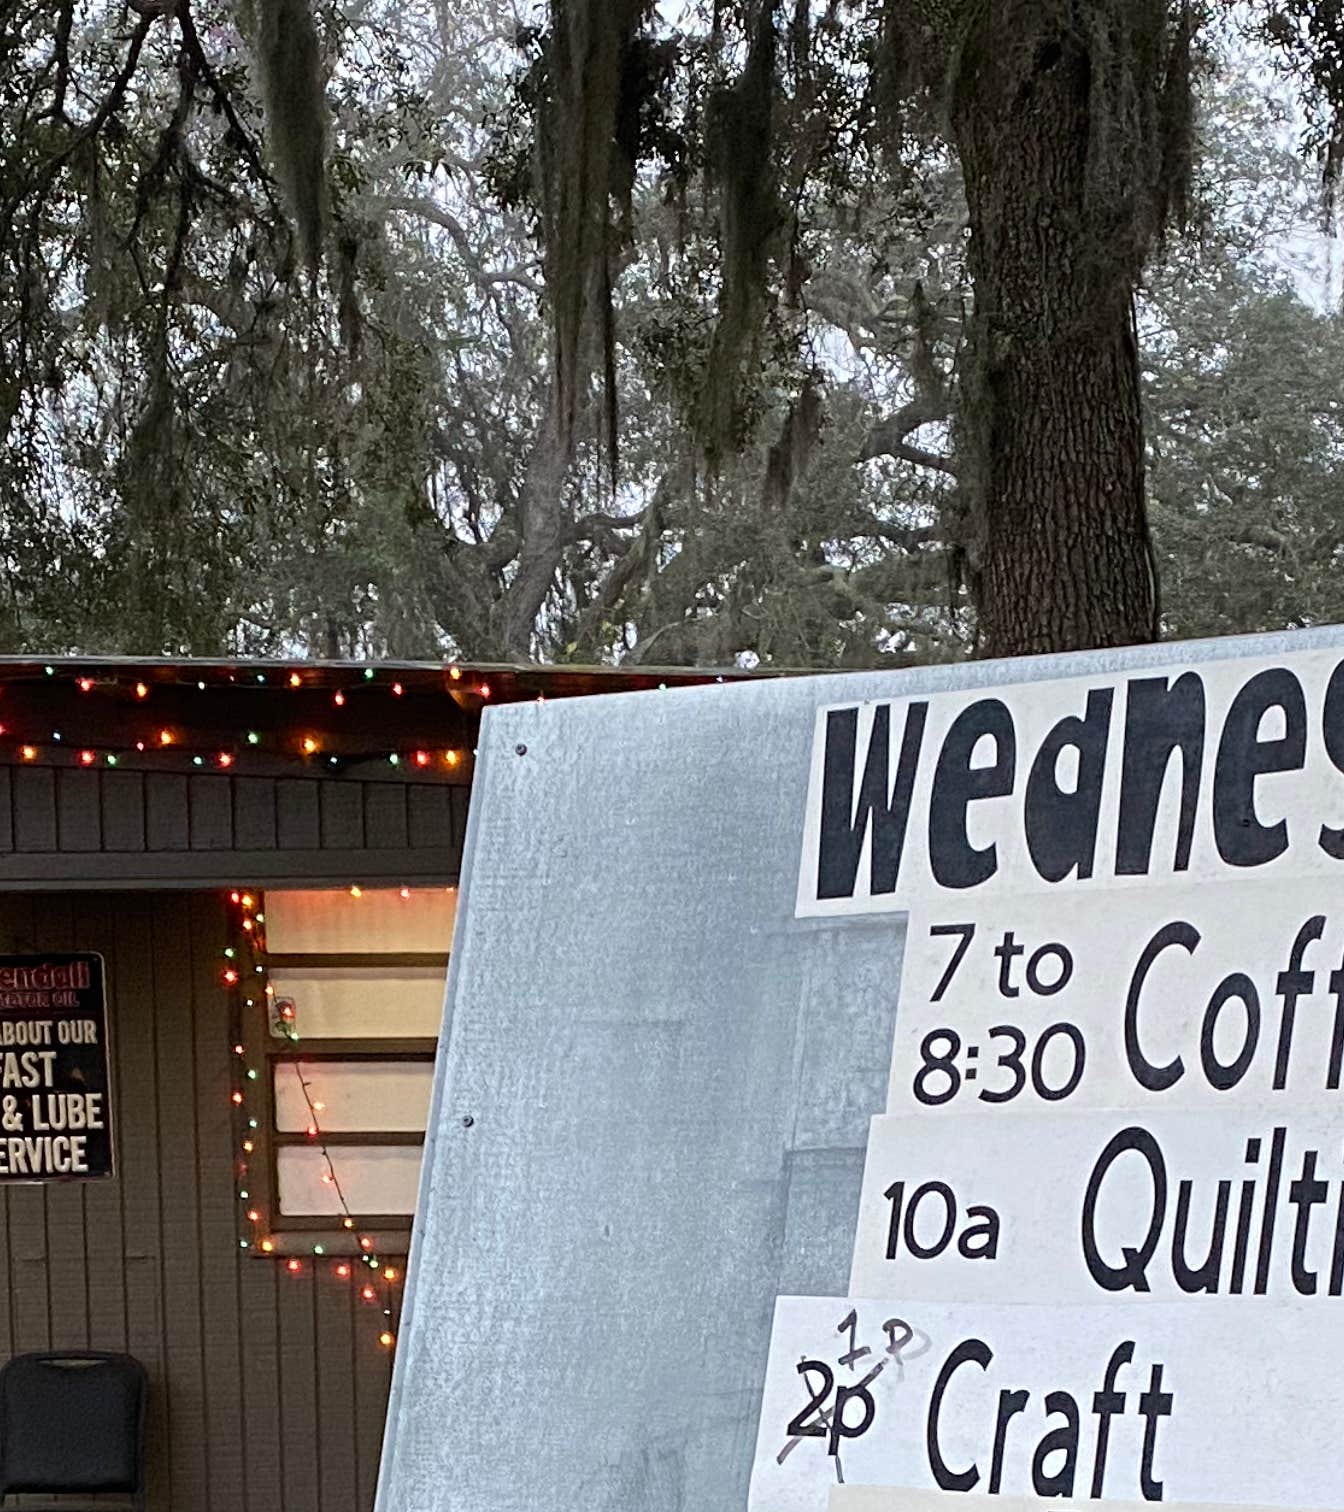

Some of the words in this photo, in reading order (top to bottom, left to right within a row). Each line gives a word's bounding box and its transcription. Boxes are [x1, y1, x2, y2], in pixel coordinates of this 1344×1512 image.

[929, 923, 976, 1002] 7
[994, 931, 1074, 998] to
[57, 1019, 98, 1045] OUR
[913, 1022, 1086, 1106] 8:30
[1, 1094, 24, 1132] &
[32, 1093, 105, 1131] LUBE
[883, 1181, 1000, 1260] 10a
[926, 1338, 1174, 1500] Craft
